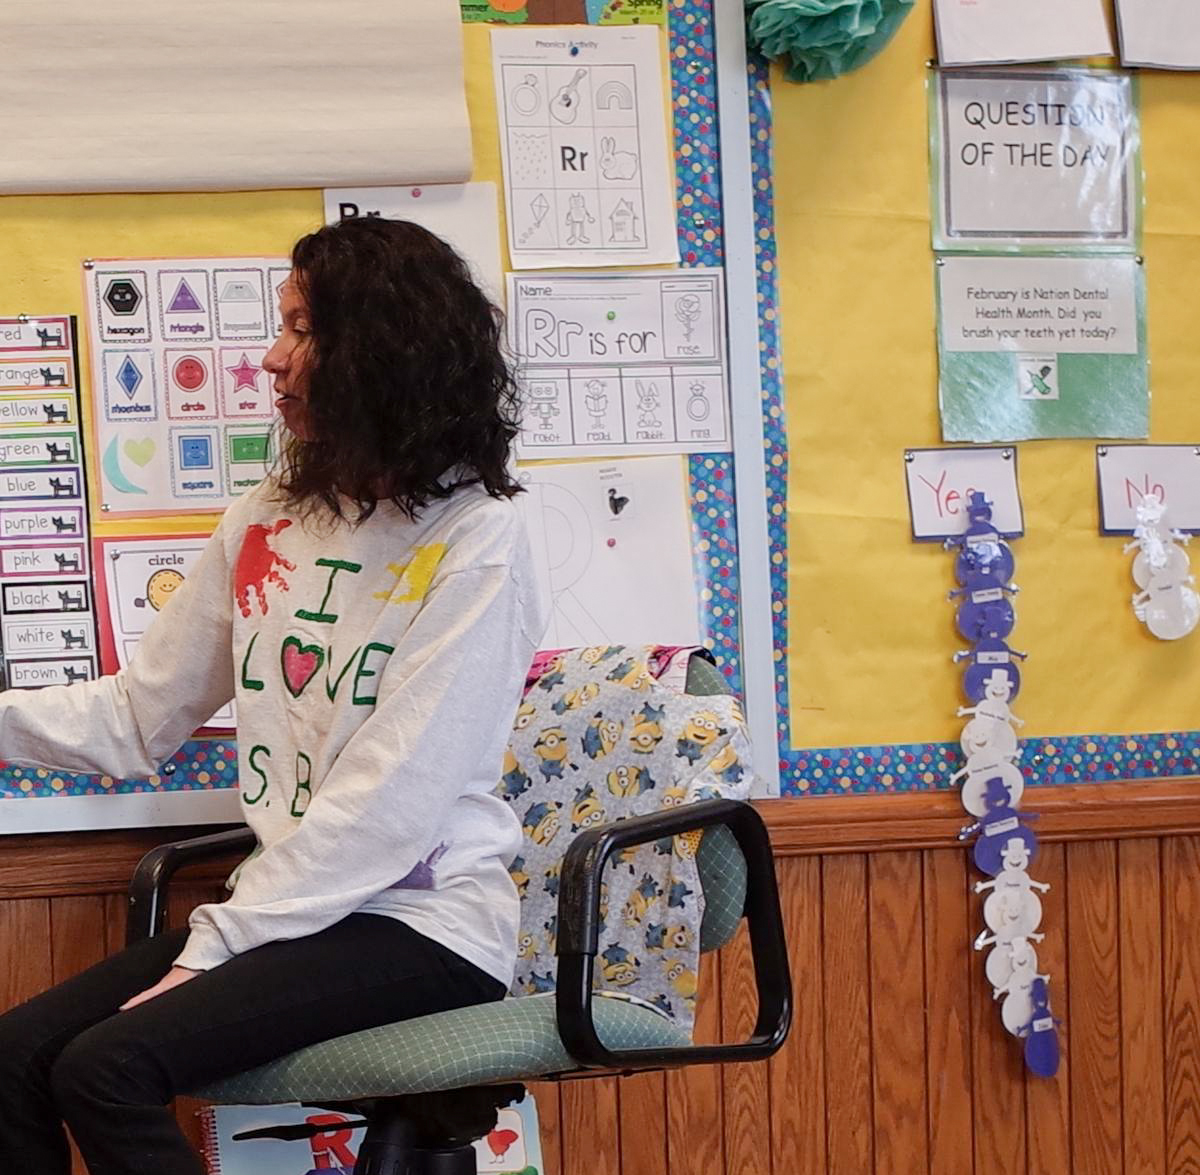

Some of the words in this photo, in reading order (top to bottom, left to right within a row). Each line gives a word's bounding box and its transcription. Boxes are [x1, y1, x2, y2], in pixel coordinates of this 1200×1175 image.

[535, 40, 566, 49] Phonics
[964, 101, 1105, 130] QUESTION
[560, 145, 589, 173] Rr
[961, 142, 996, 167] OF
[1003, 142, 1054, 168] THE
[1062, 145, 1110, 168] DAY
[519, 284, 553, 297] Name
[966, 287, 1017, 302] February
[1020, 288, 1031, 300] is
[1032, 288, 1071, 300] Nation
[1073, 288, 1110, 300] Dental
[975, 307, 1013, 319] Health
[1016, 307, 1054, 319] Month.
[1057, 308, 1077, 319] Did
[1082, 311, 1103, 322] you
[106, 325, 146, 337] hexagon
[169, 322, 206, 335] triangle
[525, 308, 584, 359] Rr
[588, 331, 608, 356] is
[615, 330, 657, 356] for
[962, 326, 994, 338] brush
[996, 330, 1020, 342] your
[1024, 327, 1055, 339] teeth
[1057, 328, 1078, 341] yet
[1080, 327, 1117, 341] today?
[676, 344, 701, 355] rose
[110, 402, 152, 414] rhombus
[180, 401, 207, 413] circle
[237, 399, 259, 411] star
[6, 477, 37, 492] blue
[4, 514, 49, 534] purple
[13, 551, 42, 571] pink
[147, 554, 185, 567] circle
[11, 590, 51, 606] black
[294, 558, 362, 624] I
[16, 626, 55, 643] white
[15, 664, 59, 681] brown
